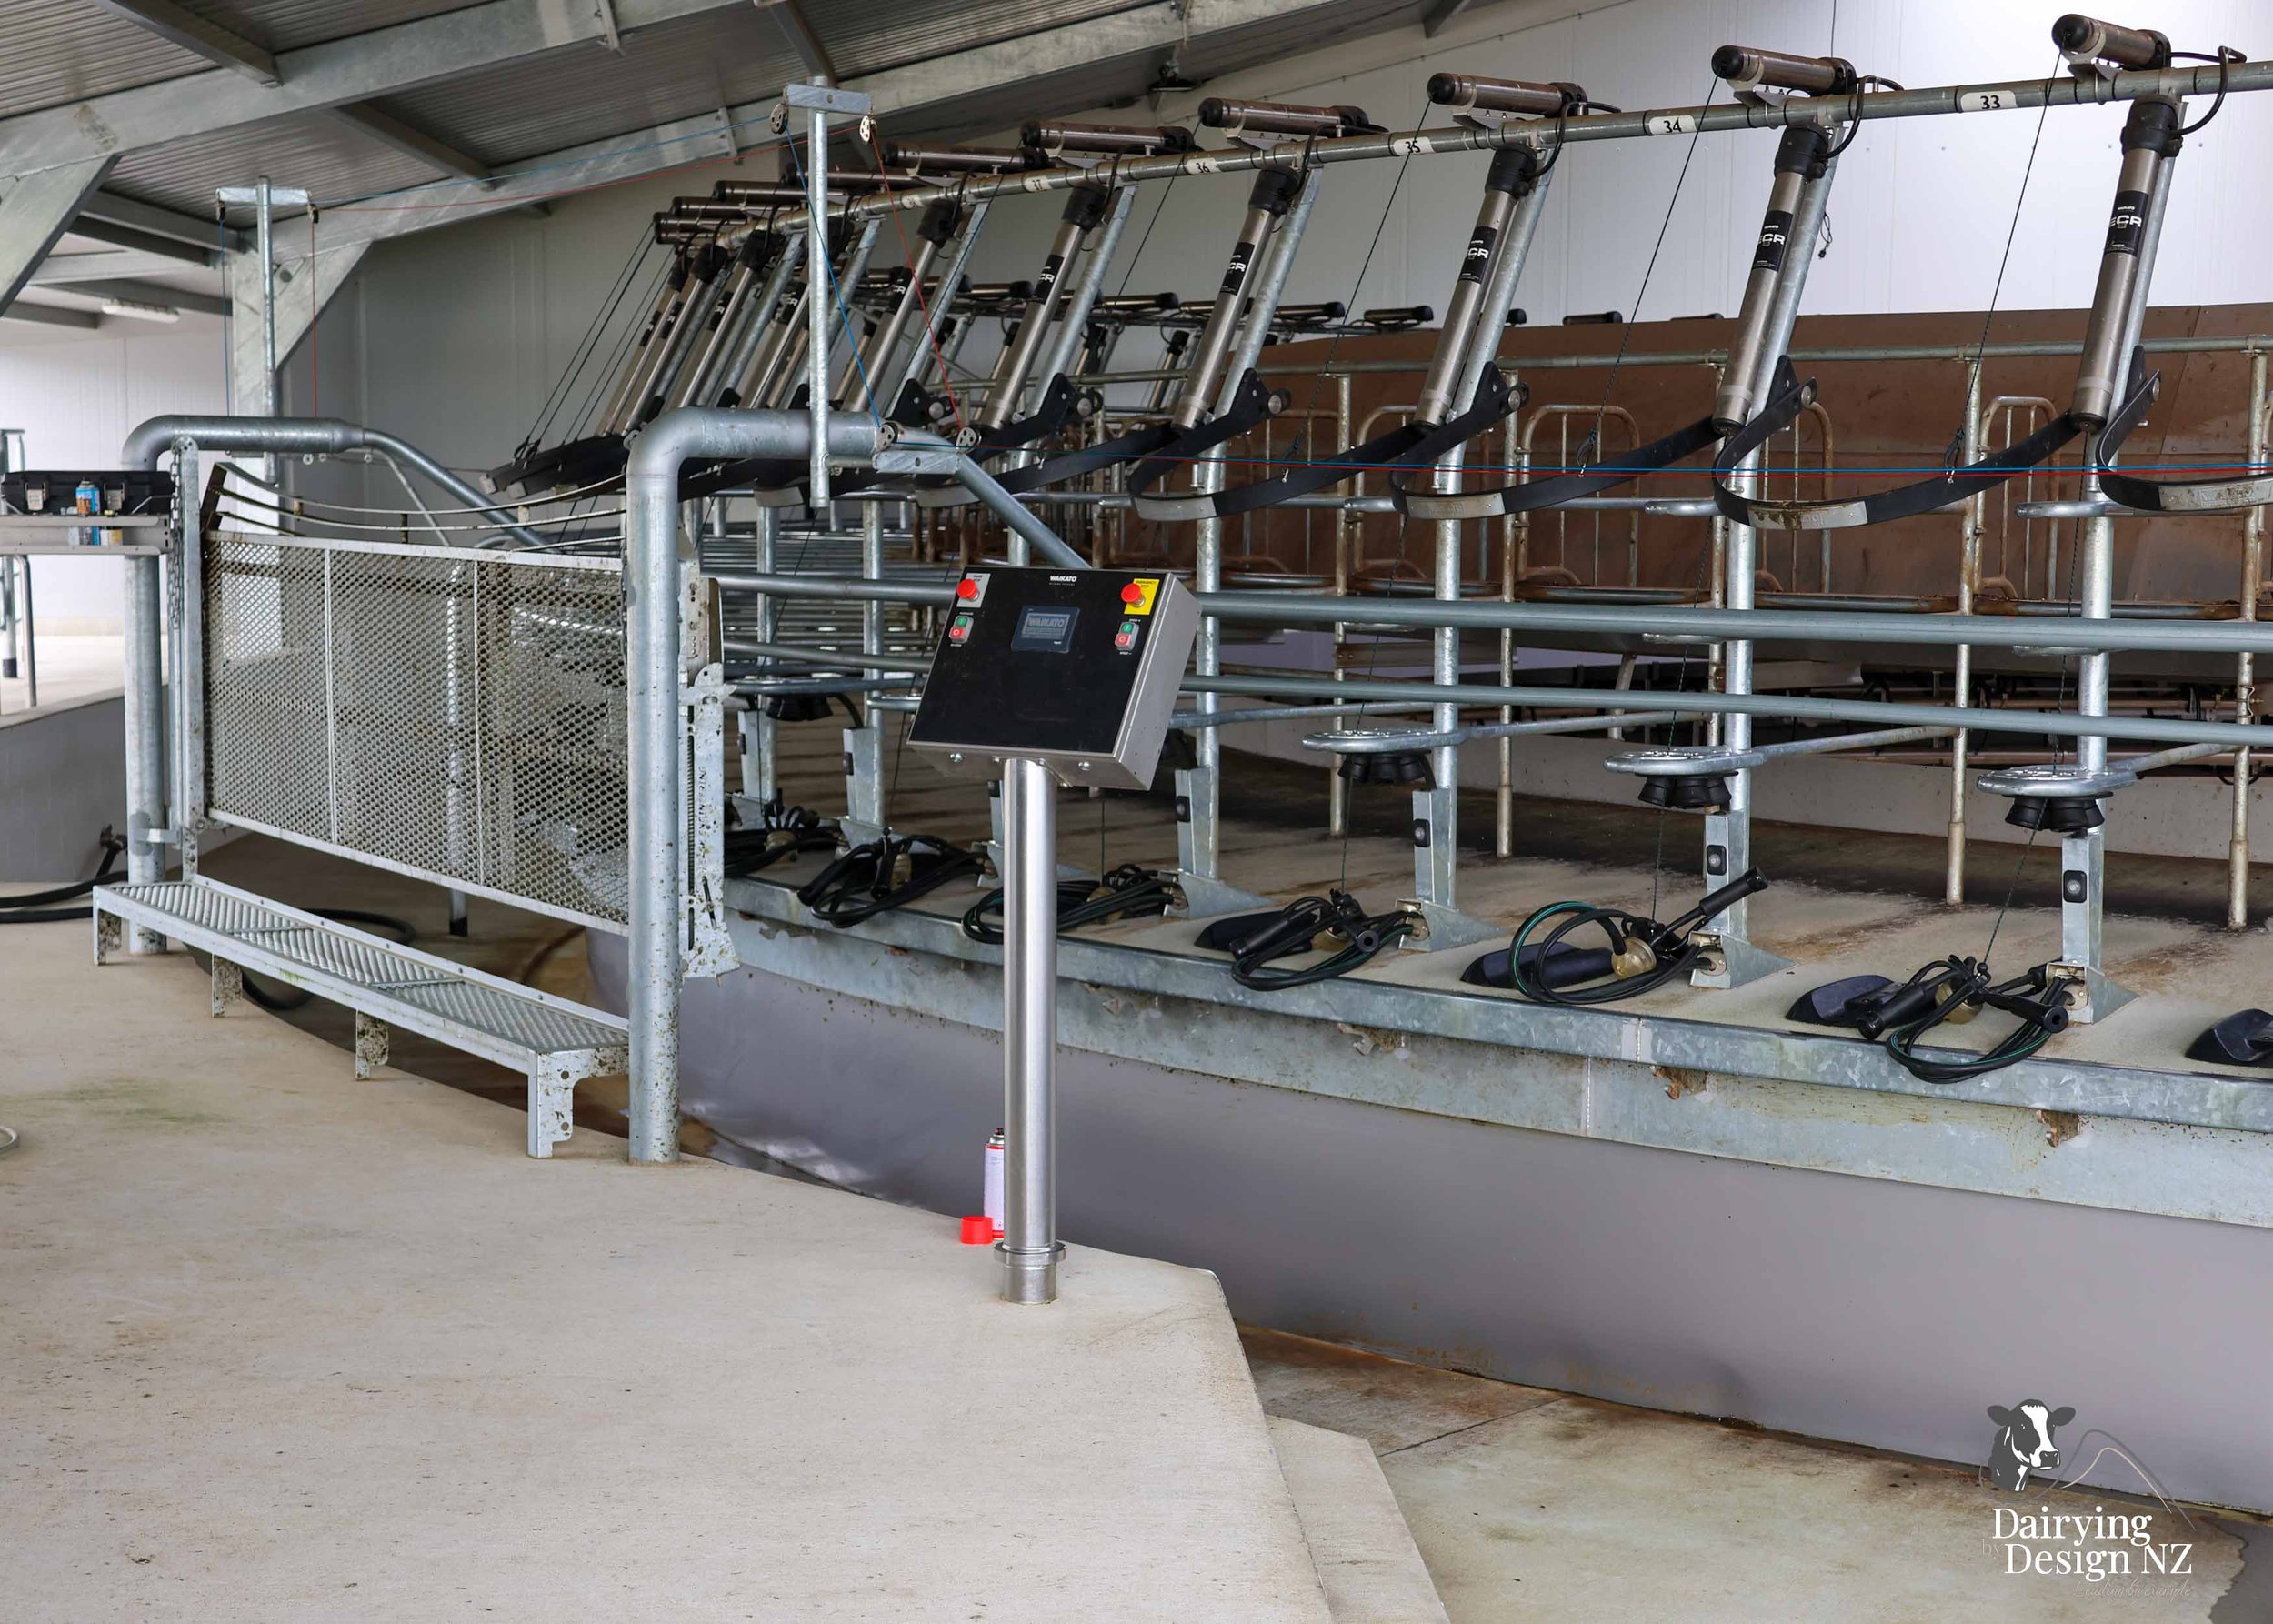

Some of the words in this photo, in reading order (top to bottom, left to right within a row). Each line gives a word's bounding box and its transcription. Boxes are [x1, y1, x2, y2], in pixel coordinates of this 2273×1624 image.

[1980, 95, 2000, 109] 33
[1664, 117, 1682, 133] 34
[1405, 140, 1420, 153] 35
[1196, 162, 1210, 173] 36
[2109, 215, 2142, 227] ECR
[1049, 575, 1077, 583] WAIKATO
